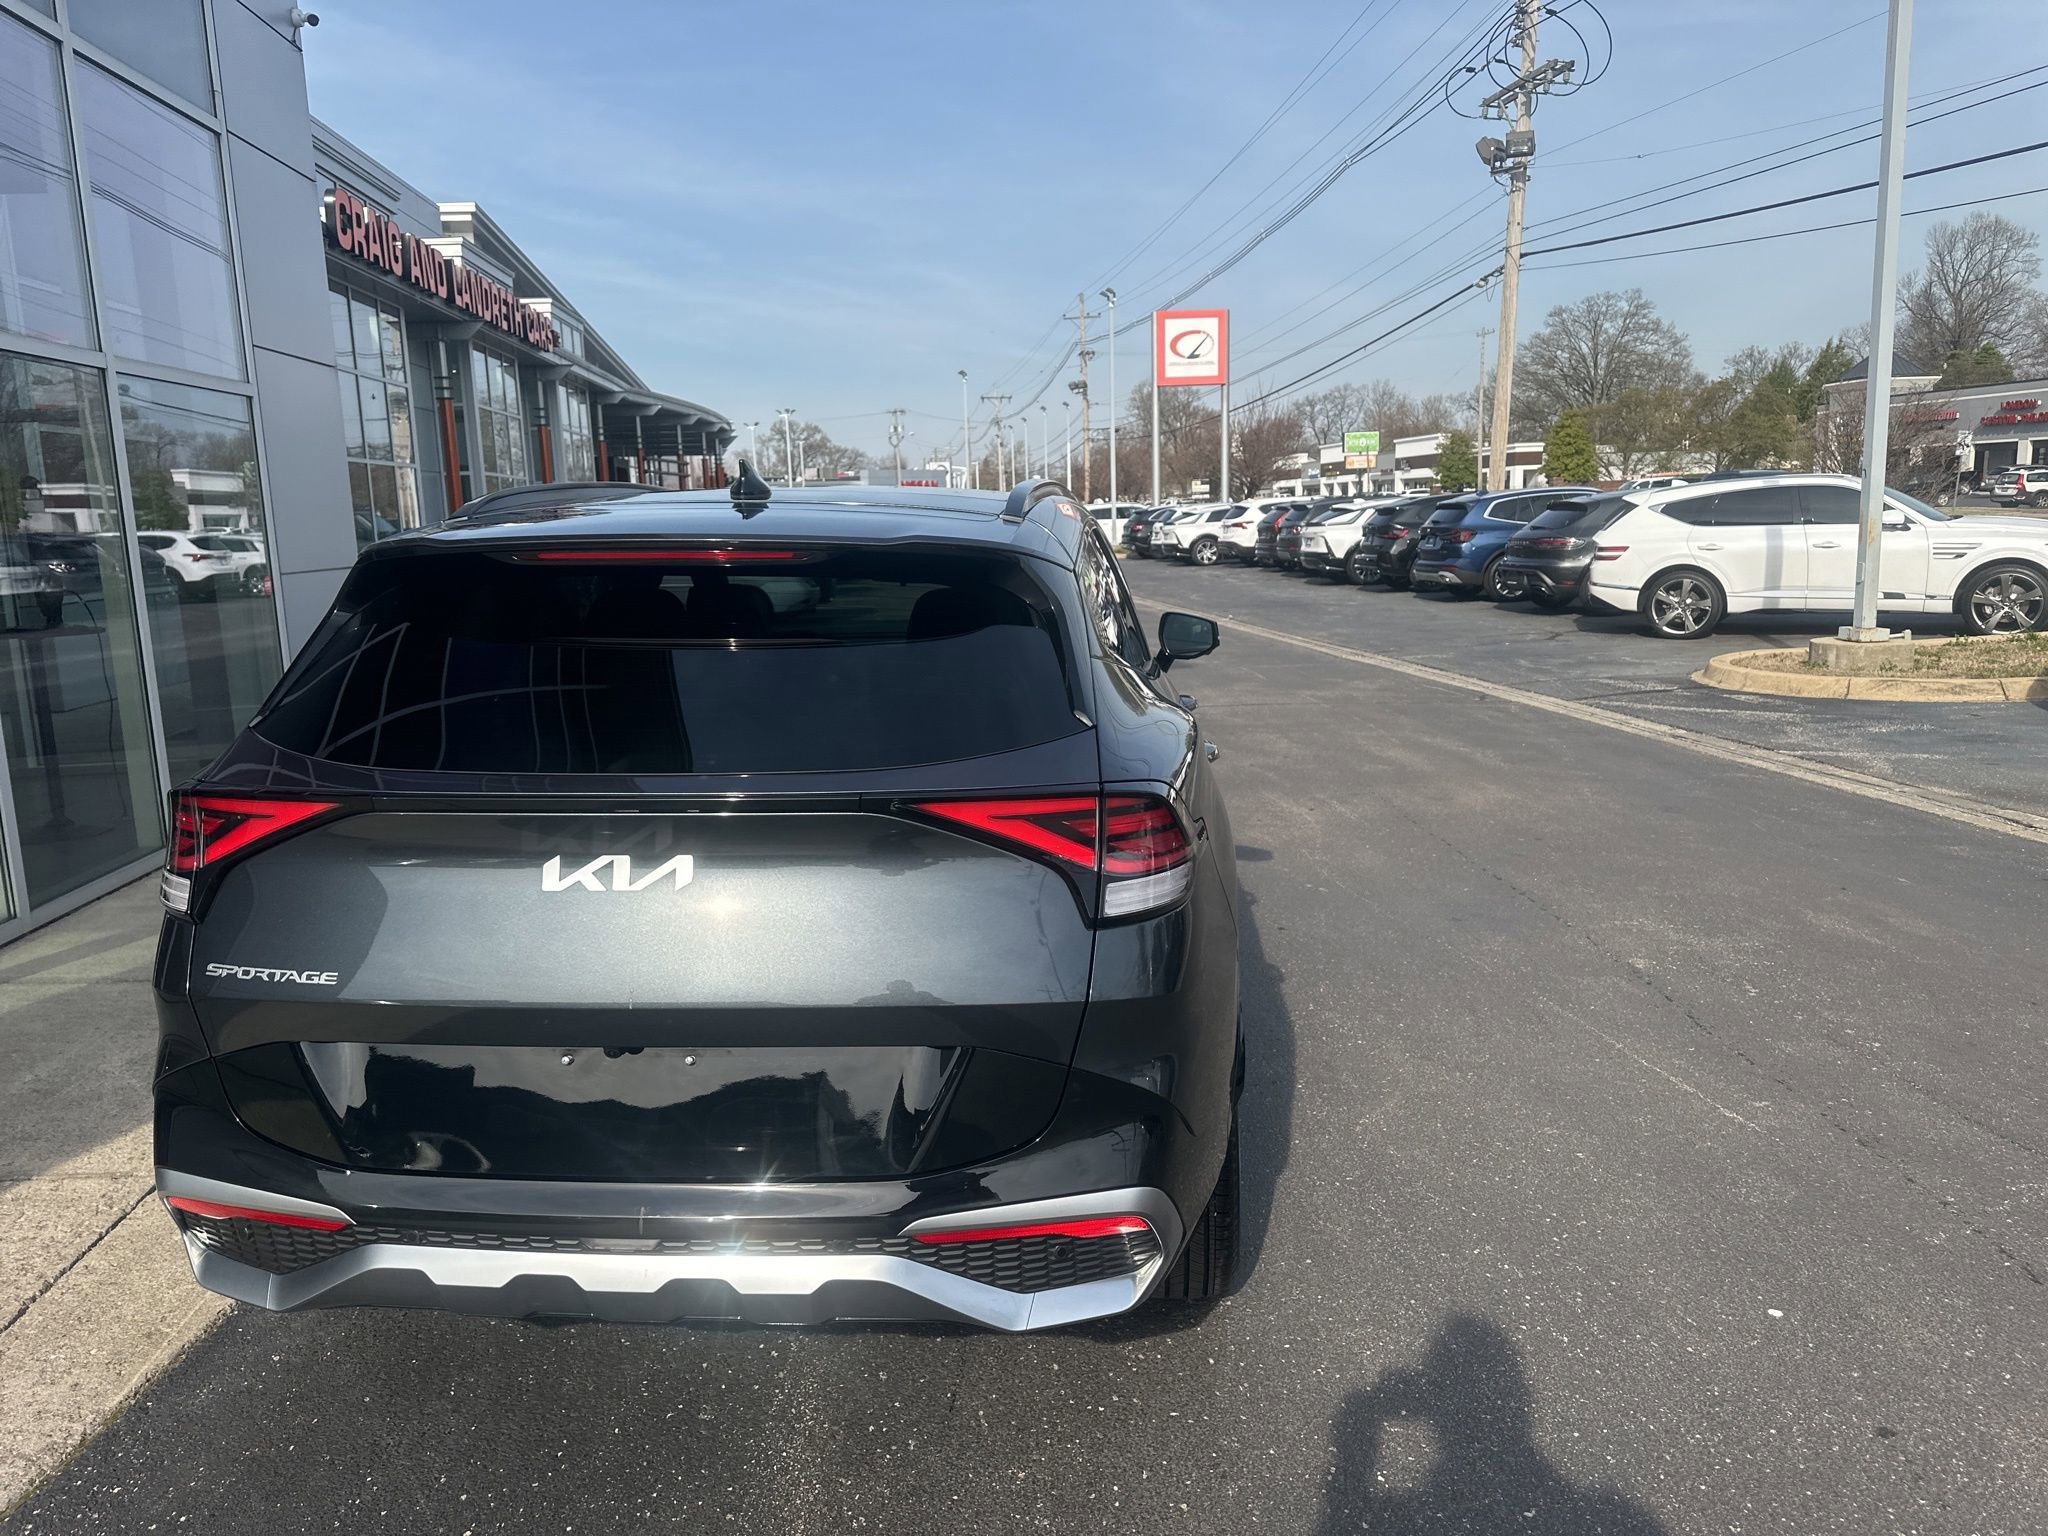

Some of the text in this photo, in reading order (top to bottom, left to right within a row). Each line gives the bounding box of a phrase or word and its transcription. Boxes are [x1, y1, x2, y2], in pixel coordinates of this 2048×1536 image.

[334, 188, 554, 353] CRAIG AND LANDRETH CARS
[541, 854, 694, 892] KIA
[205, 962, 339, 985] SPORTAGE
